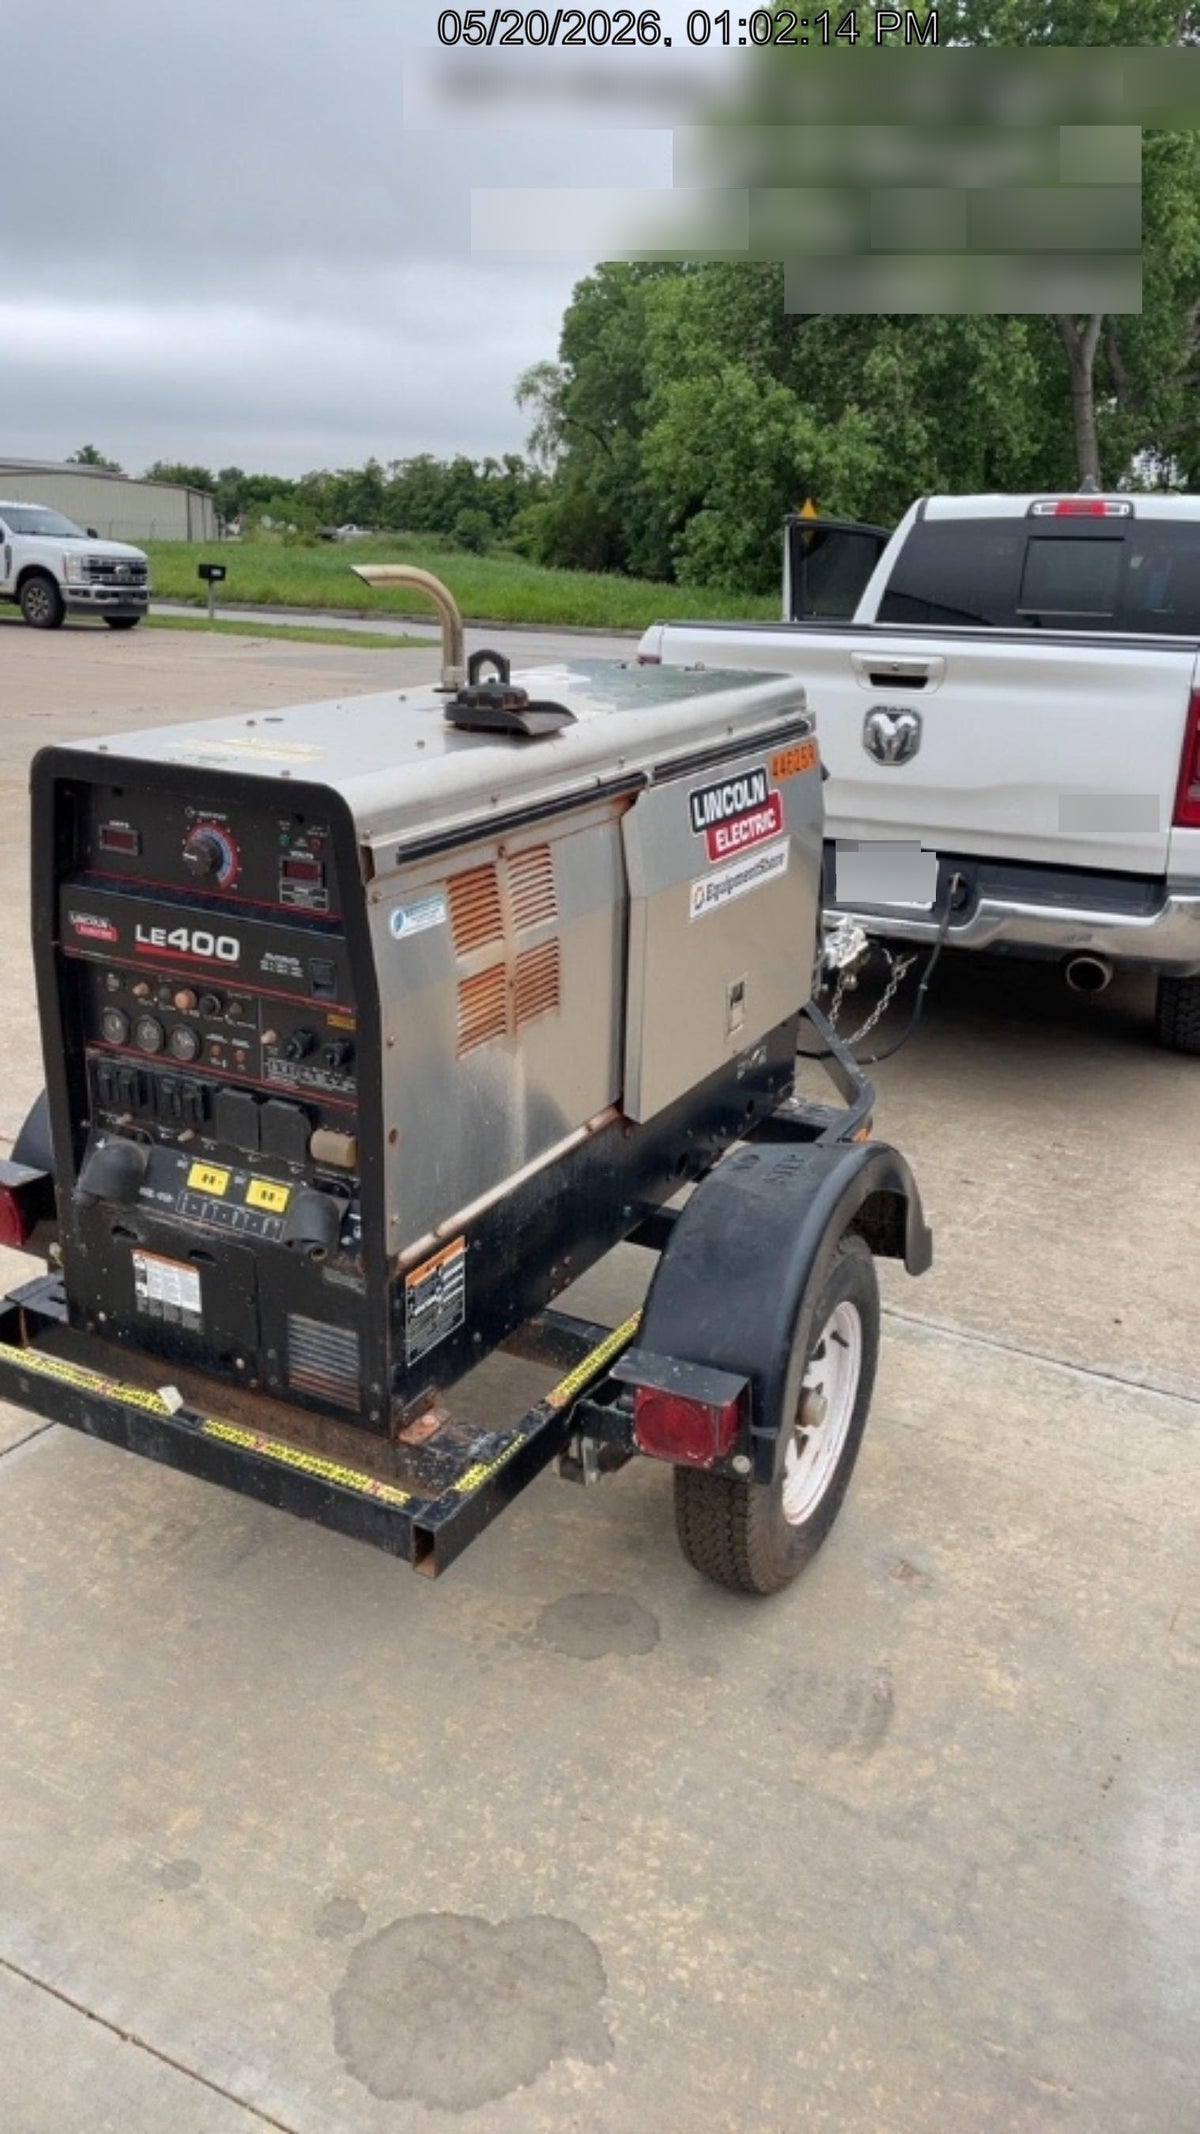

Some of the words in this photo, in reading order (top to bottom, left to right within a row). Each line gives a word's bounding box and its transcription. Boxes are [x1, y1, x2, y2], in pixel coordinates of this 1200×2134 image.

[693, 773, 766, 826] LINCOLN
[716, 808, 776, 851] ELECTRIC
[706, 851, 785, 904] EquipmentShare
[135, 924, 240, 962] LE400
